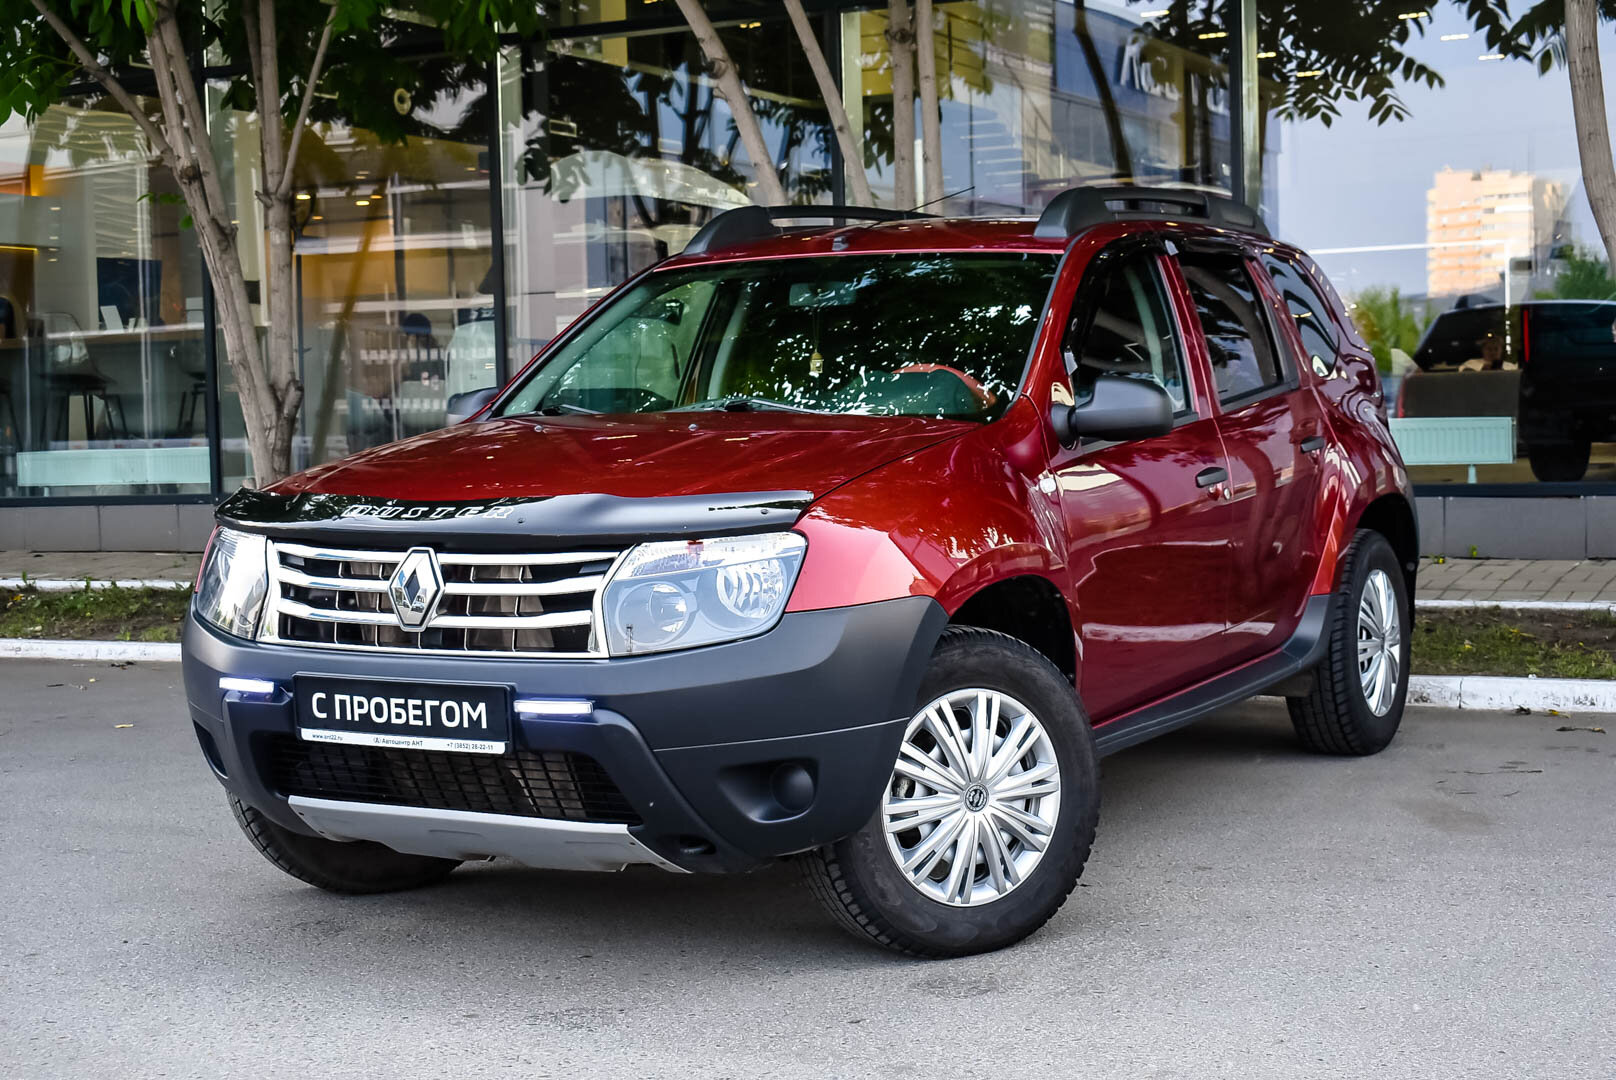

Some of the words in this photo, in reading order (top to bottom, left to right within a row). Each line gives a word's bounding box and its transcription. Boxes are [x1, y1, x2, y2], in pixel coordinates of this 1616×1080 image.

[340, 504, 515, 519] DUSTER
[311, 692, 328, 719] С
[334, 693, 488, 729] ПРОБЕГОМ
